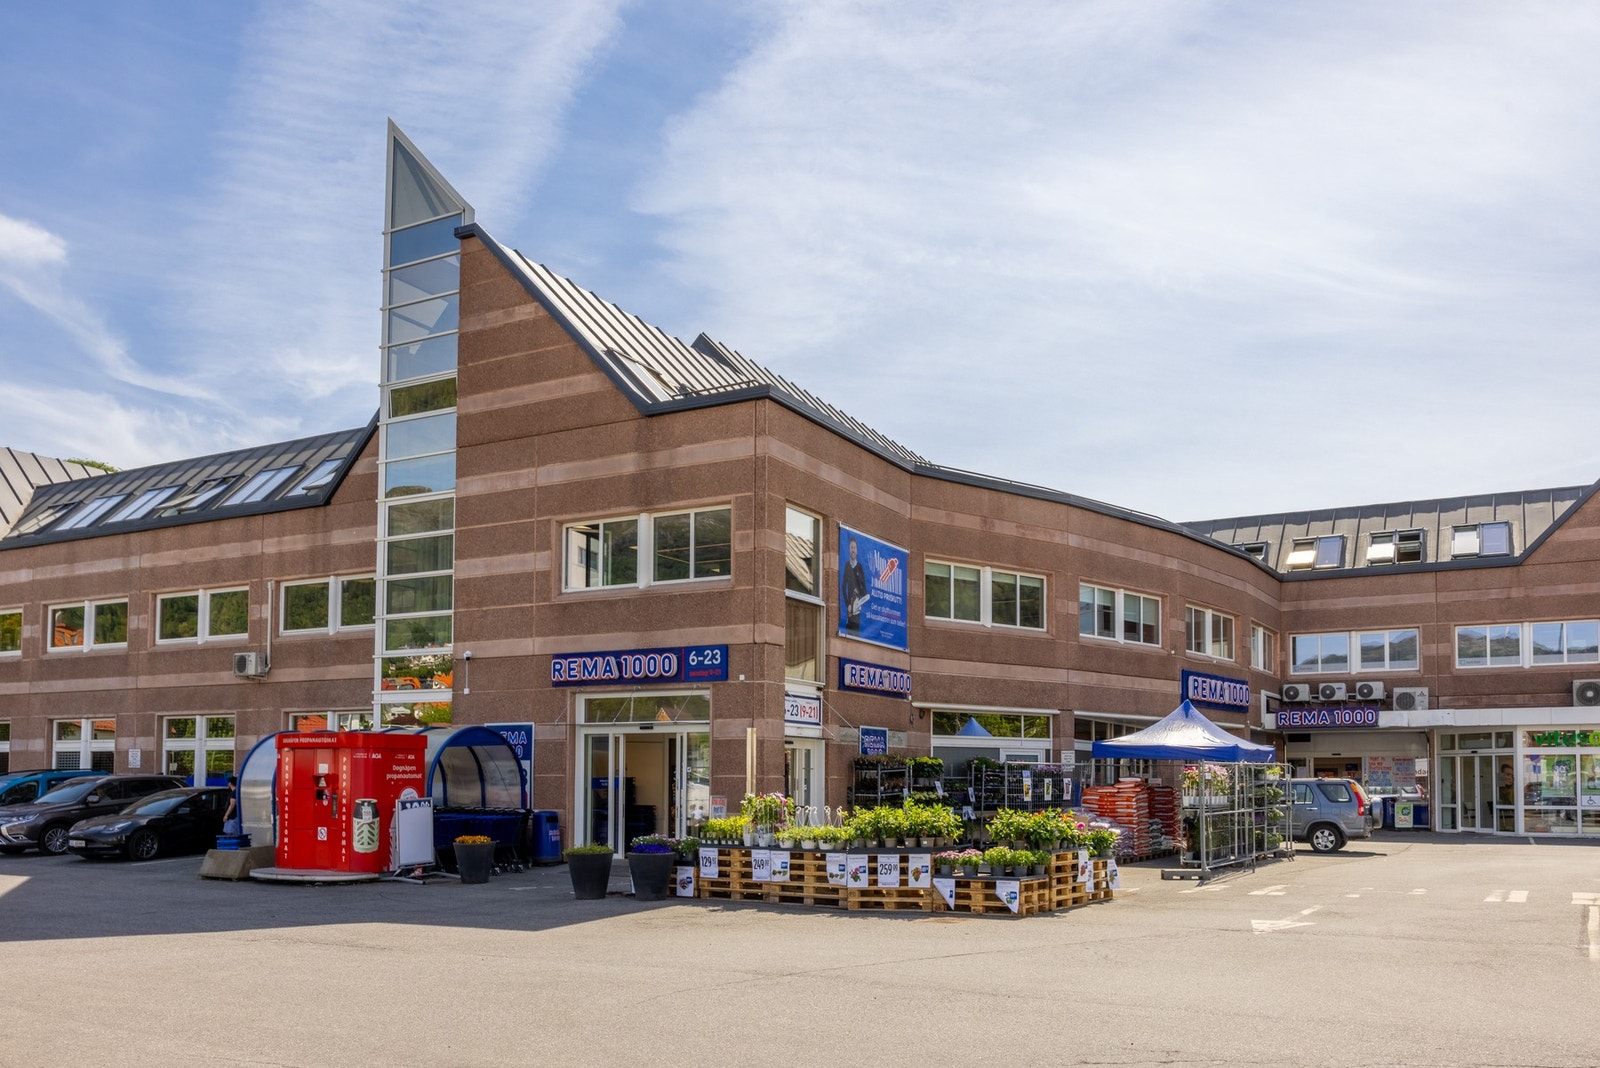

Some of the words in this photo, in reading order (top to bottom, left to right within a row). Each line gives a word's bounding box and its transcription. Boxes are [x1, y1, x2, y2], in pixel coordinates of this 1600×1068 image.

[689, 649, 721, 666] 6-23
[552, 657, 615, 681] REMA
[621, 653, 674, 678] 1000
[850, 664, 885, 689] REMA
[887, 671, 912, 693] 1000
[1192, 676, 1225, 703] REMA
[1227, 682, 1250, 706] 1000
[785, 703, 799, 717] -23
[1278, 711, 1330, 726] REMA
[1333, 709, 1376, 725] 1000
[386, 773, 422, 781] propanautomat
[701, 856, 712, 868] 129
[753, 858, 765, 870] 249
[879, 863, 893, 875] 259
